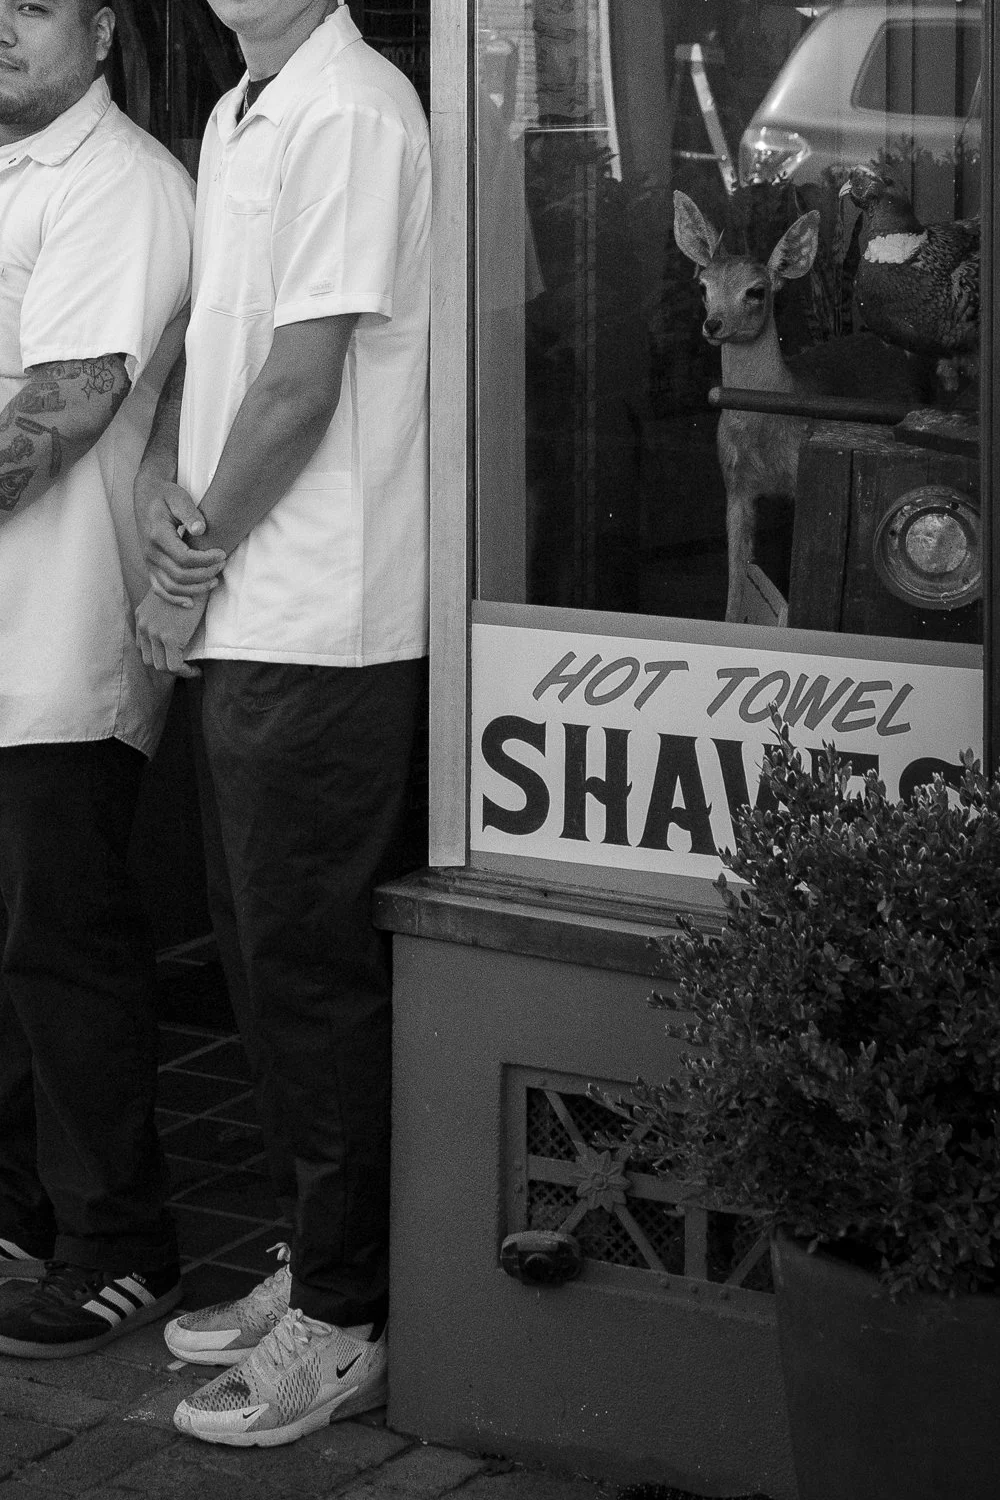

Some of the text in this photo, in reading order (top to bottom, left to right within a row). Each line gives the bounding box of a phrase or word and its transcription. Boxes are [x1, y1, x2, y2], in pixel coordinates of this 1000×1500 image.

[532, 650, 915, 736] HOT TOWEL
[481, 714, 970, 857] SHAV
